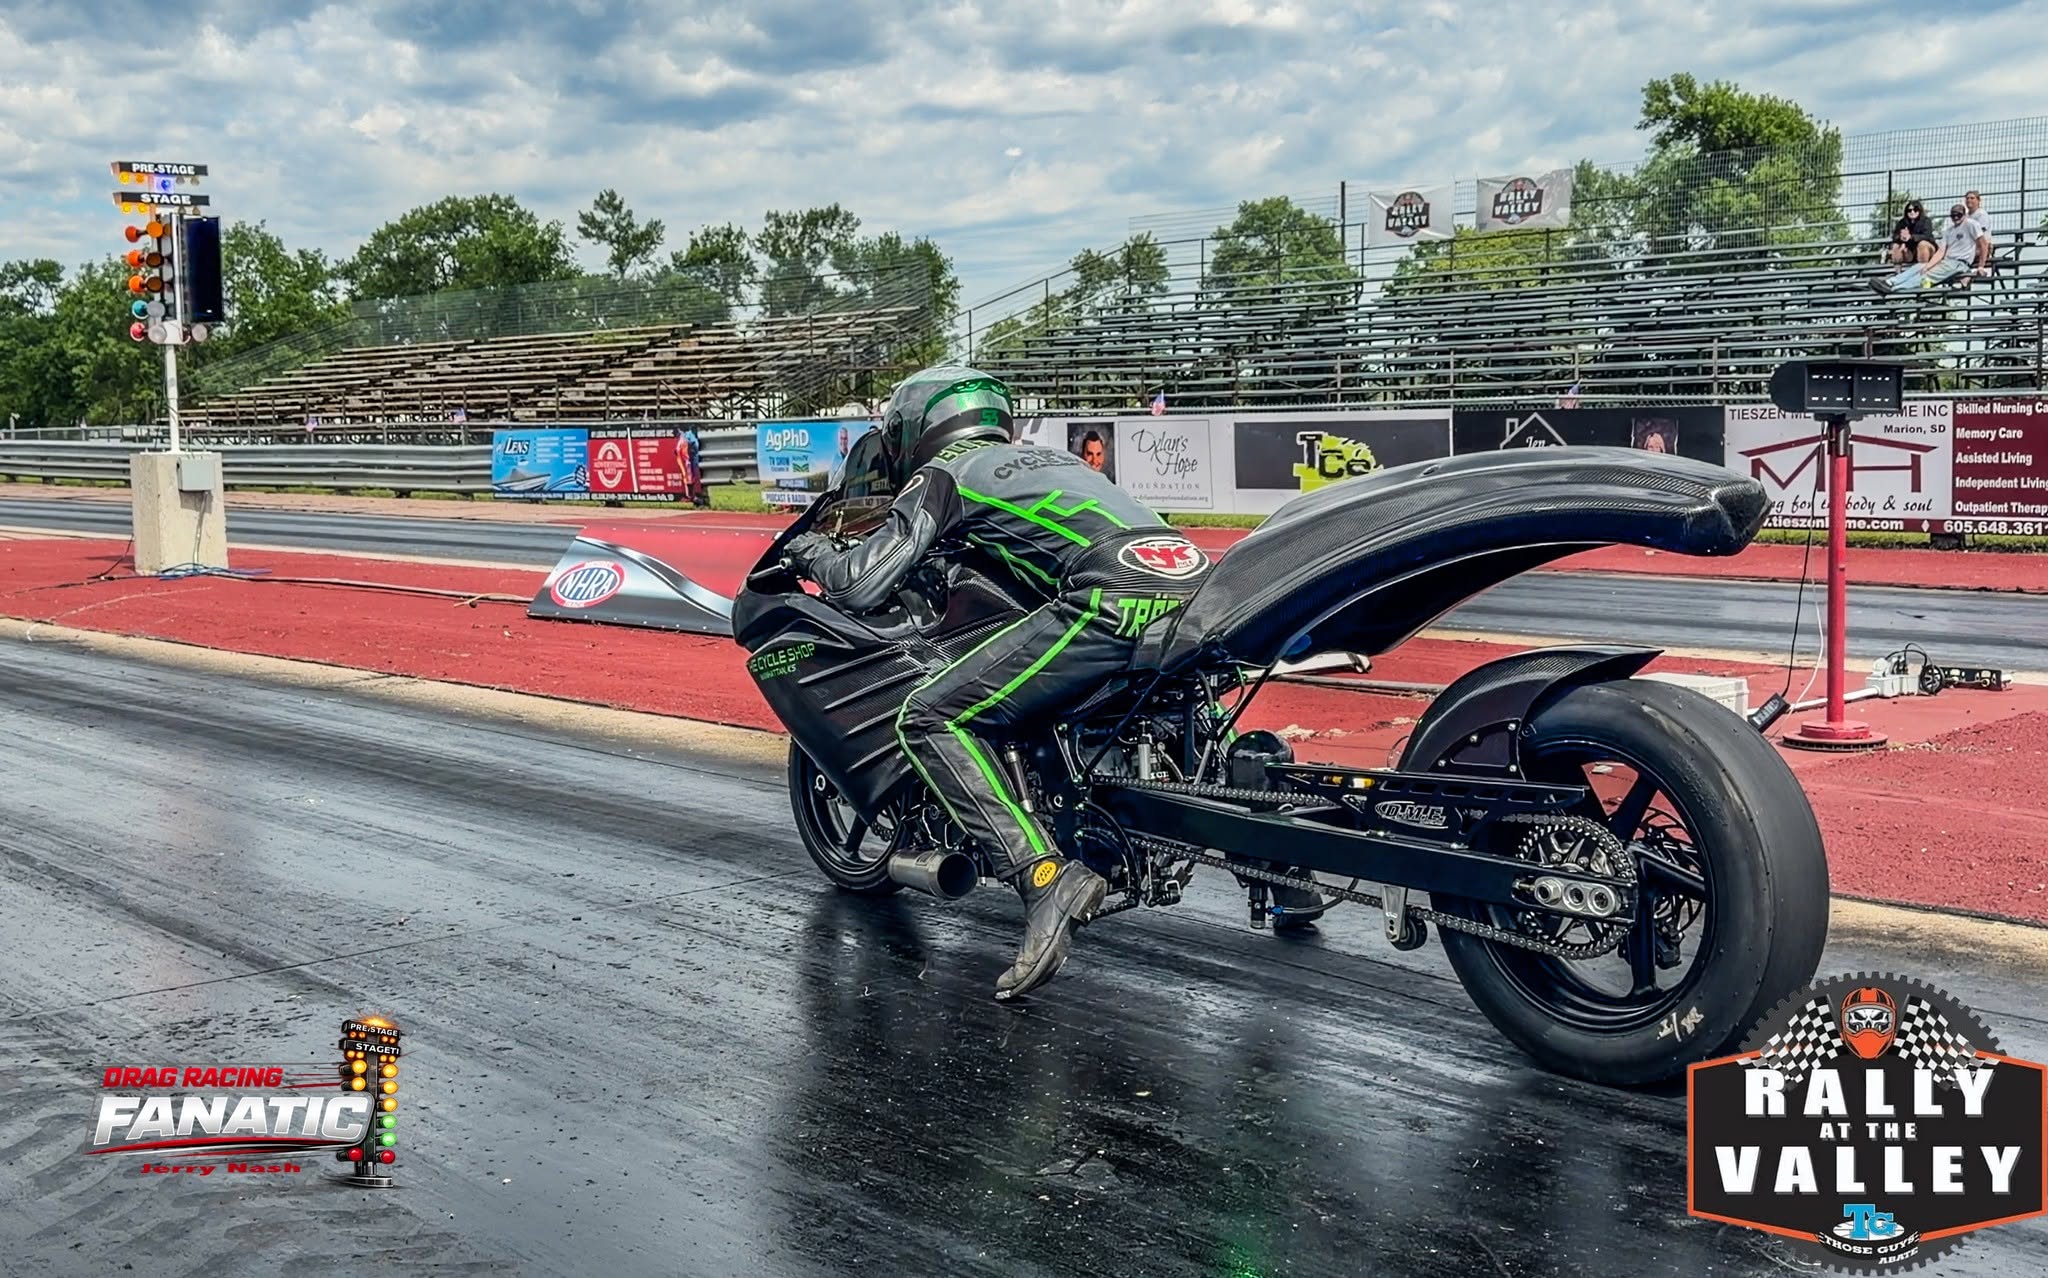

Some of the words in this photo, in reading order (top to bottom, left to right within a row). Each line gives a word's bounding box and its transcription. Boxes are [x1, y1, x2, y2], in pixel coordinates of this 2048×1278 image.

[132, 163, 195, 175] PRE-STAGE
[141, 193, 191, 205] STAGE
[1500, 190, 1537, 202] RALLY
[1494, 202, 1539, 215] VALLEY
[1729, 407, 1787, 420] TIESZEN
[1923, 404, 1949, 417] INC
[1956, 403, 1991, 414] Skilled
[1993, 402, 2033, 416] Nursing
[1884, 424, 1927, 434] Marion,
[1930, 424, 1946, 433] SD
[1956, 427, 1996, 441] Memory
[1998, 427, 2023, 438] Care
[765, 428, 809, 451] AgPhD
[1131, 429, 1189, 465] Dylan's
[1156, 449, 1198, 480] Hope
[1956, 452, 1999, 463] Assisted
[2001, 452, 2033, 466] Living
[1132, 482, 1200, 490] FOUNDATION
[1956, 477, 2018, 491] Independent
[1846, 495, 1876, 515] body
[1883, 495, 1896, 510] &
[1903, 498, 1933, 511] soul
[1956, 501, 2008, 514] Outpatient
[2010, 501, 2048, 516] Therap
[559, 567, 616, 600] NHRA
[758, 650, 787, 671] CYCLE
[787, 643, 815, 662] SHOP
